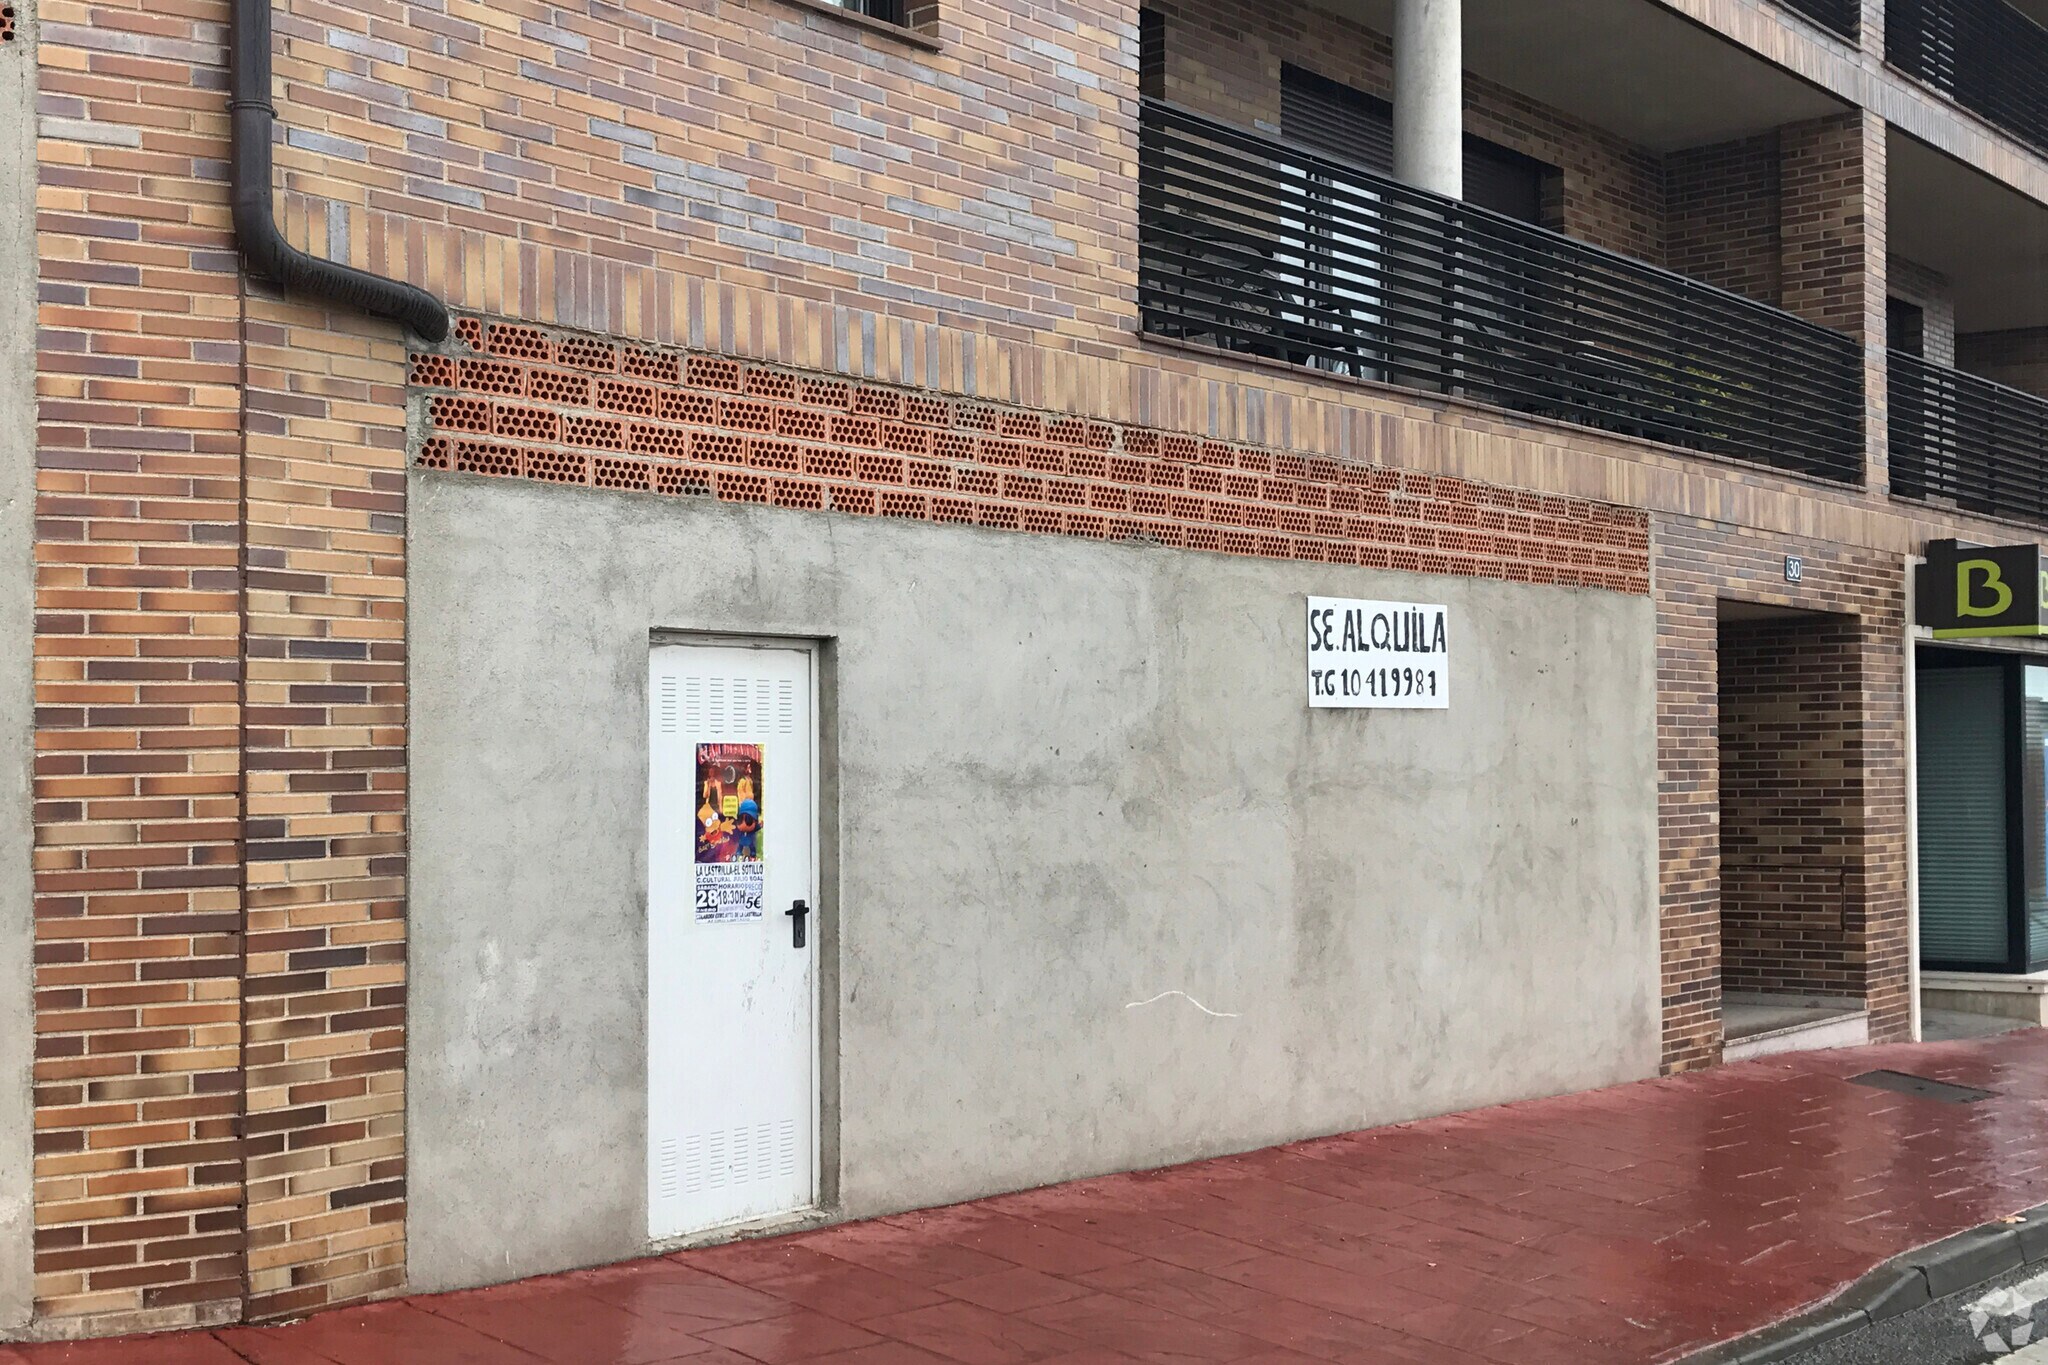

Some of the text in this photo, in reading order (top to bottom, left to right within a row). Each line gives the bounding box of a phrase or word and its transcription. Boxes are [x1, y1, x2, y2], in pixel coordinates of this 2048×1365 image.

[1788, 560, 1800, 578] 30
[1956, 559, 2013, 617] B
[742, 864, 764, 875] SOTILLO
[696, 890, 718, 907] 28
[745, 895, 761, 909] 5€
